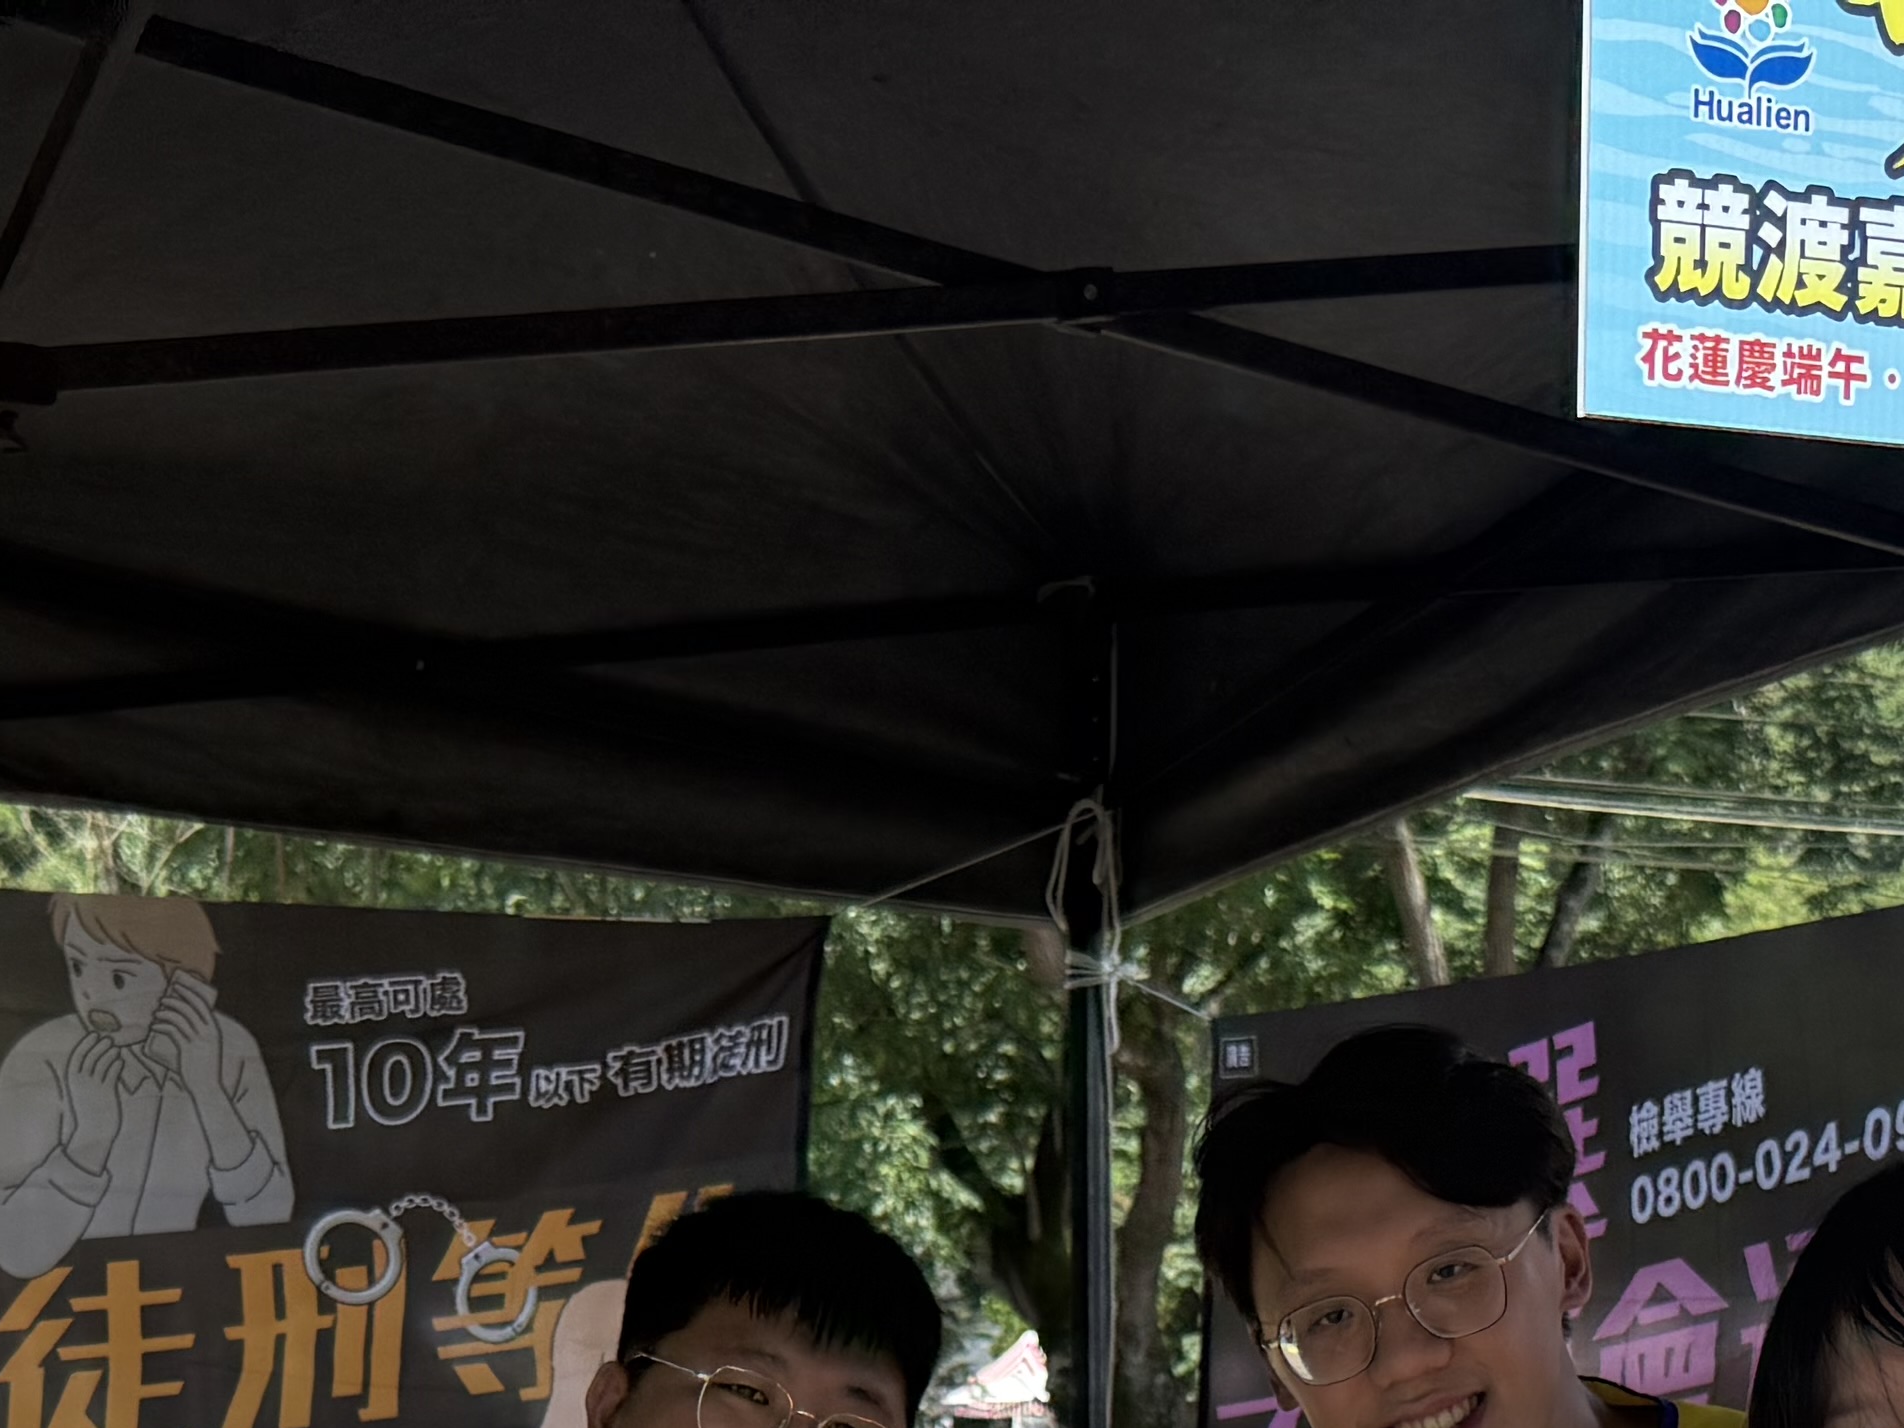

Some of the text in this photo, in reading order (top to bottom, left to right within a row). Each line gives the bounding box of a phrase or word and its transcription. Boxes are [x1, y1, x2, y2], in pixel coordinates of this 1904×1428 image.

[1693, 90, 1811, 133] Hualien
[304, 969, 468, 1026] 最高可處
[1629, 1065, 1767, 1159] 檢舉專線
